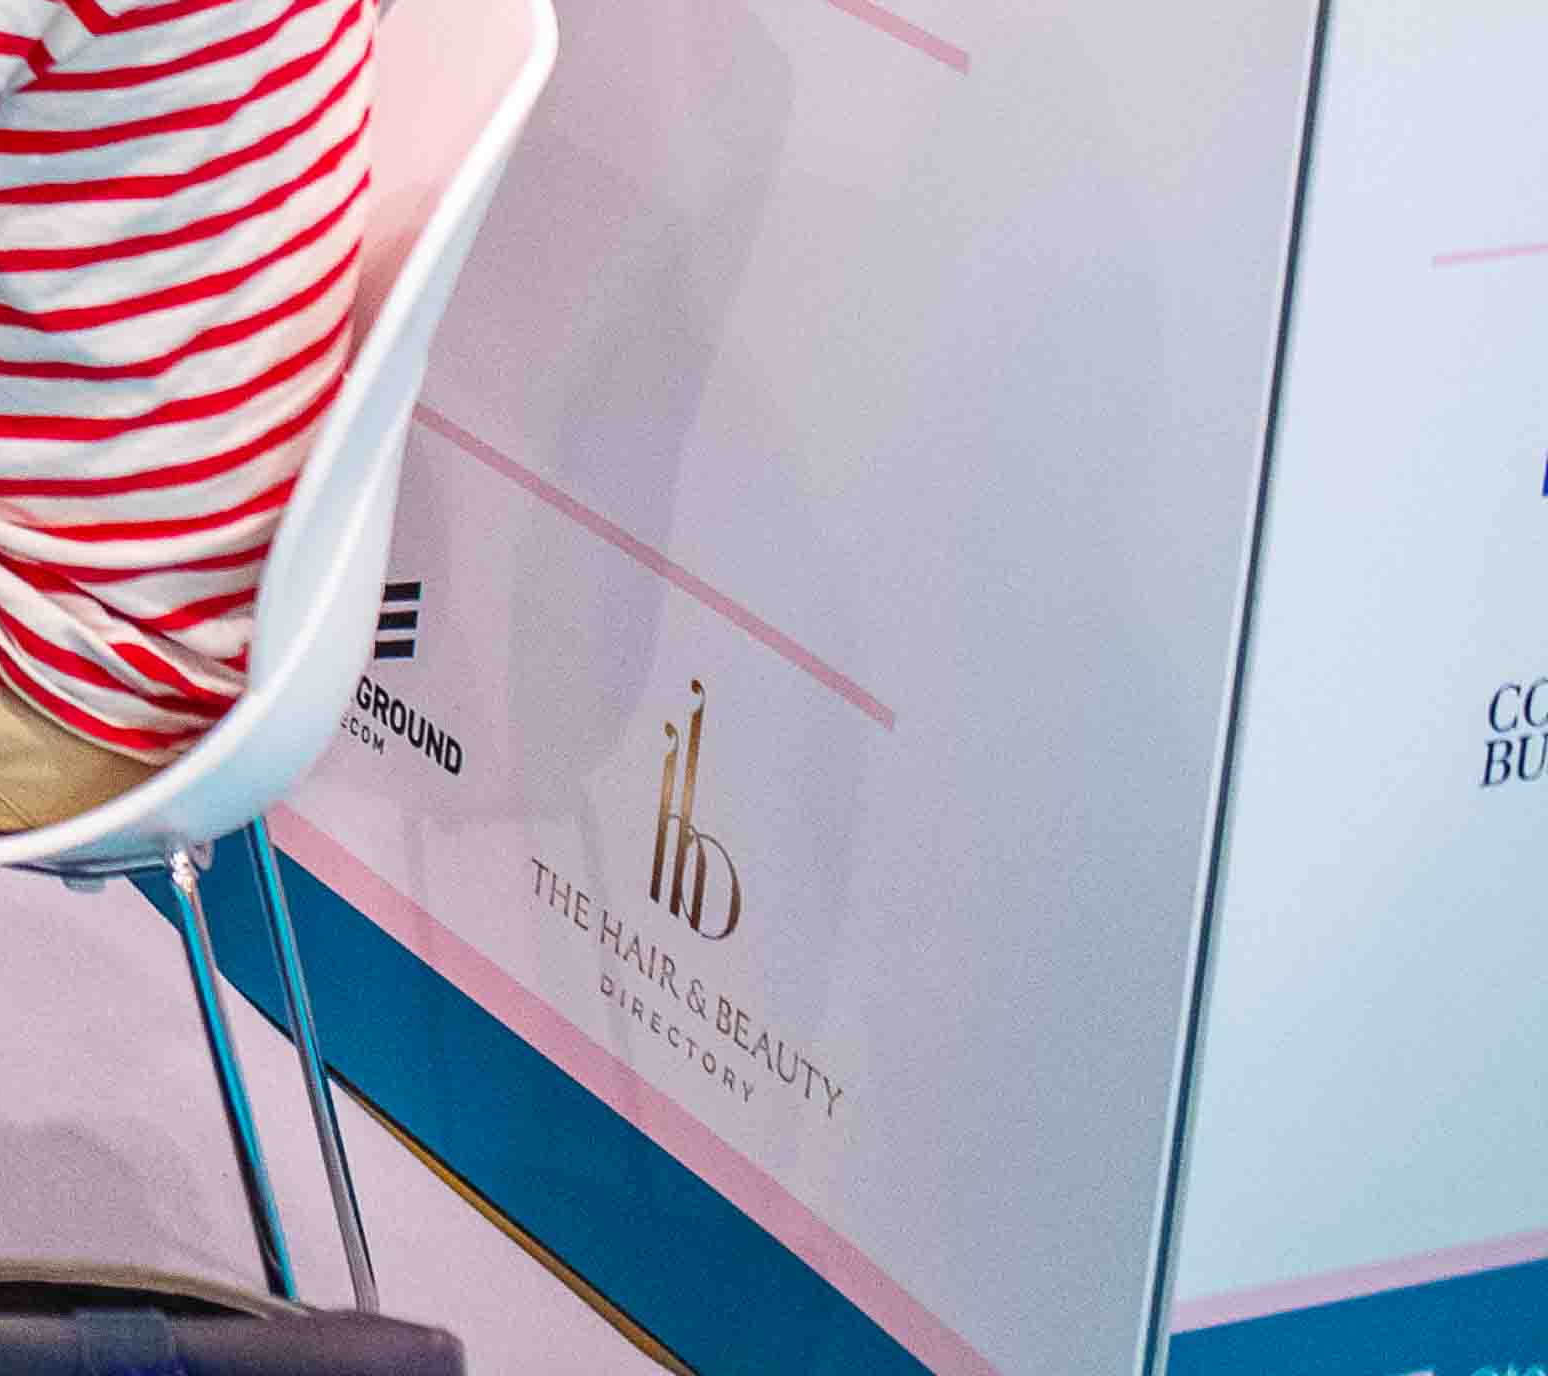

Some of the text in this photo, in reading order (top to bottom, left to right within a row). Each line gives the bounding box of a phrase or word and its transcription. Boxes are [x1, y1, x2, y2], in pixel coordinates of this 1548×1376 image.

[355, 674, 463, 777] GROUND
[531, 857, 844, 1118] THE HAIR & BEAUTY
[599, 975, 756, 1103] DIRECTORY
